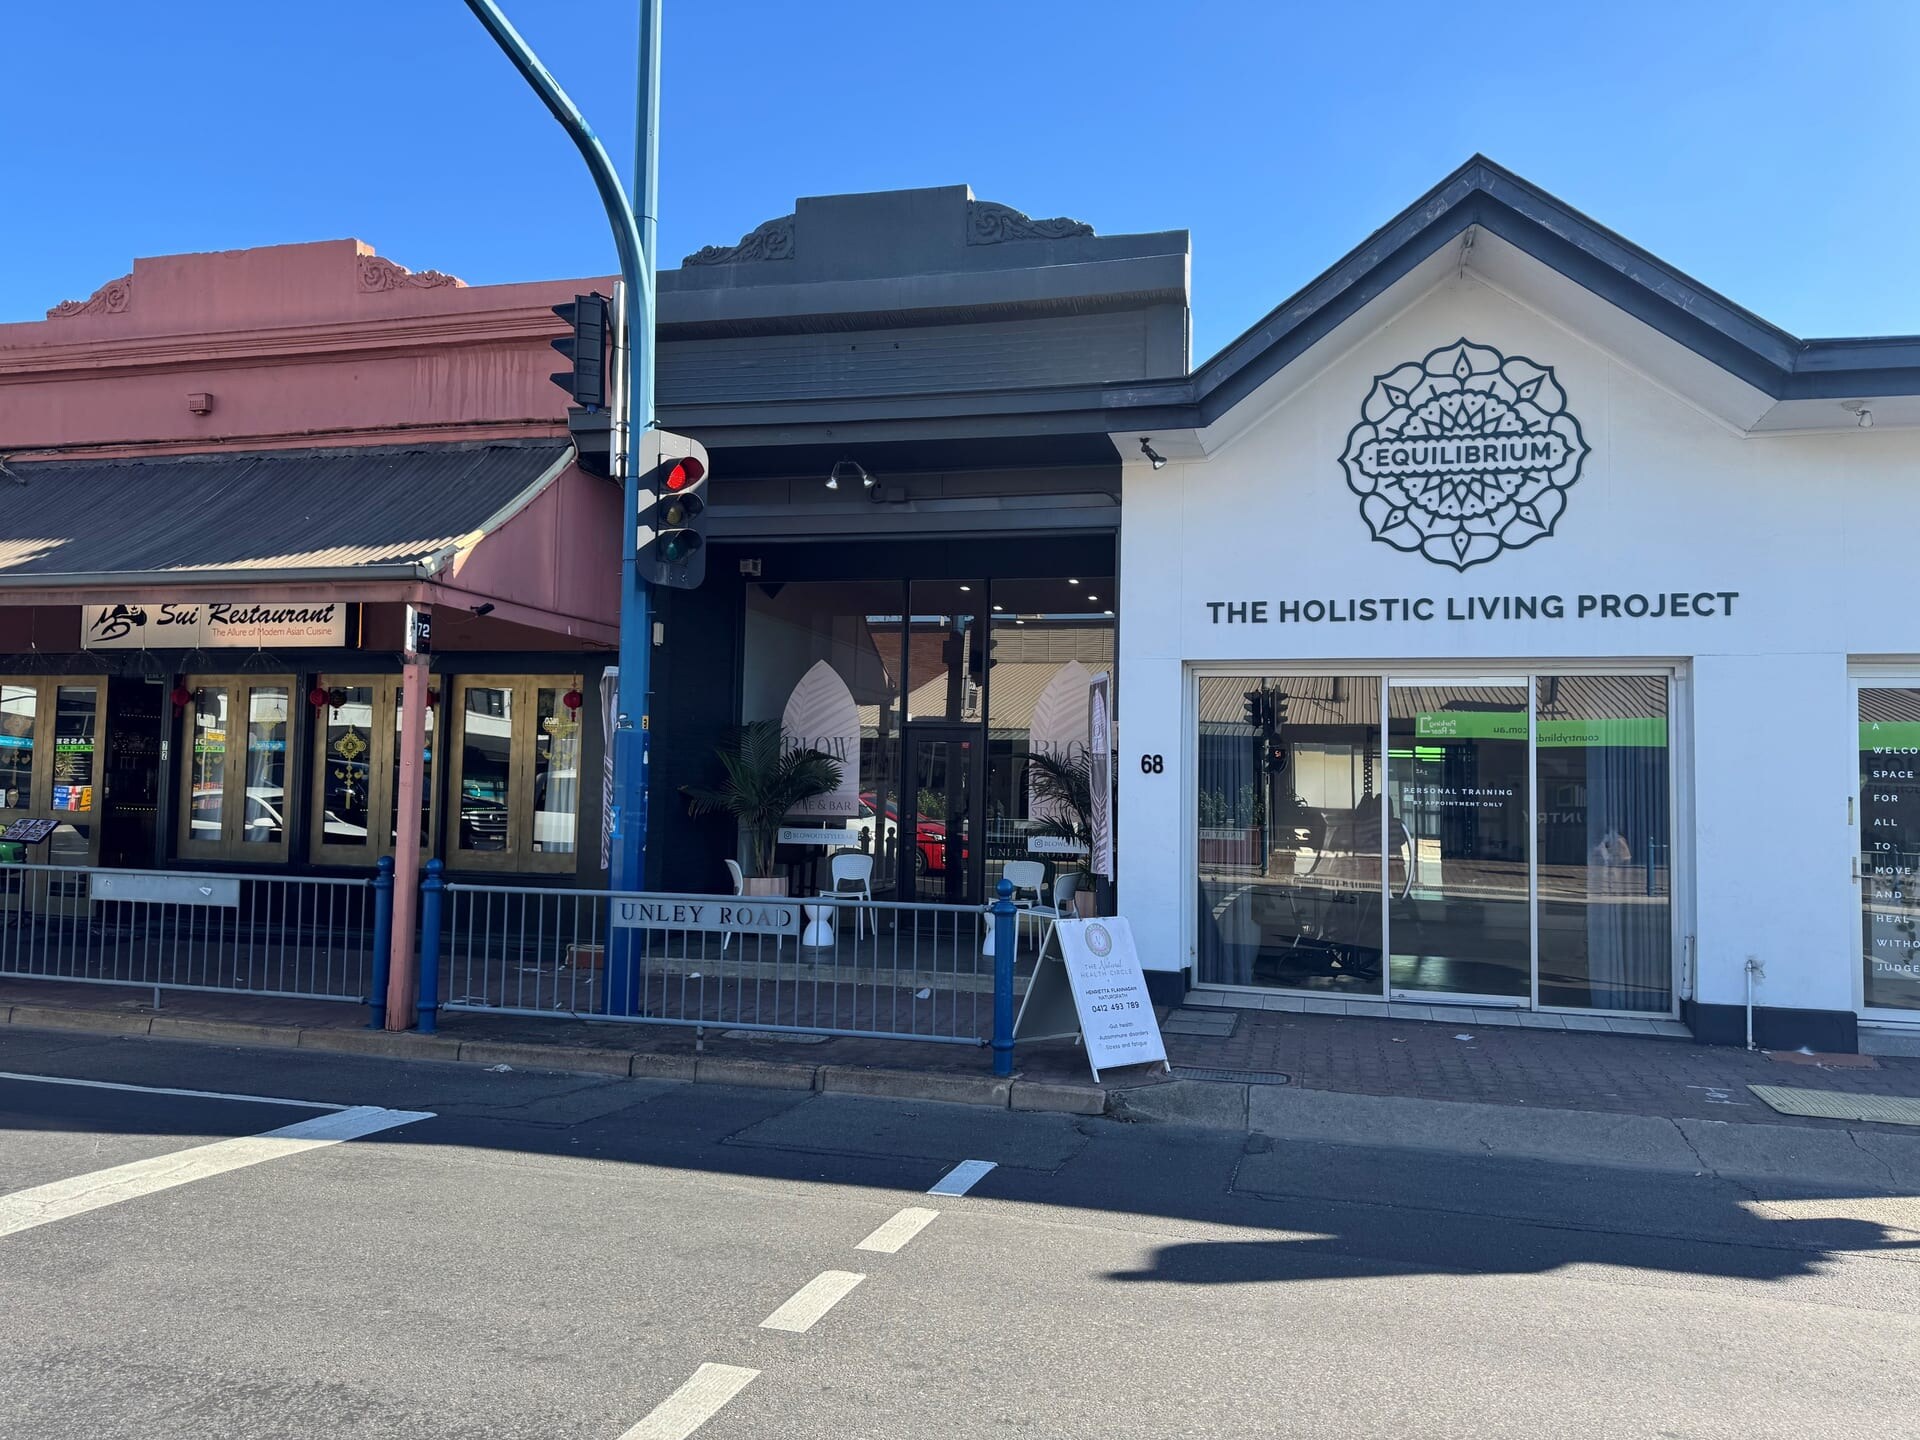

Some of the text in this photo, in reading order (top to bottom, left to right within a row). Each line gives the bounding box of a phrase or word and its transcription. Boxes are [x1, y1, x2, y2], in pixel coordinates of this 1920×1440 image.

[1375, 440, 1552, 468] EQUILIBRIUM
[1206, 592, 1740, 625] THE HOLISTIC LIVING PROJECT
[156, 603, 335, 627] Sui Restaurant
[212, 627, 333, 637] The Allure of Modern Asian Cuisine
[417, 622, 430, 638] 72
[1872, 722, 1880, 730] A
[1141, 754, 1164, 774] 68
[1873, 770, 1914, 779] SPACE
[1403, 787, 1513, 796] PERSONAL TRAINING
[1873, 794, 1899, 802] FOR
[829, 801, 852, 810] BAR
[1873, 818, 1898, 826] ALL
[1875, 866, 1911, 875] MOVE
[1875, 891, 1902, 899] AND
[620, 903, 792, 927] UNLEY ROAD
[1876, 915, 1910, 924] HEAL
[1091, 1001, 1140, 1013] 0412 493 789
